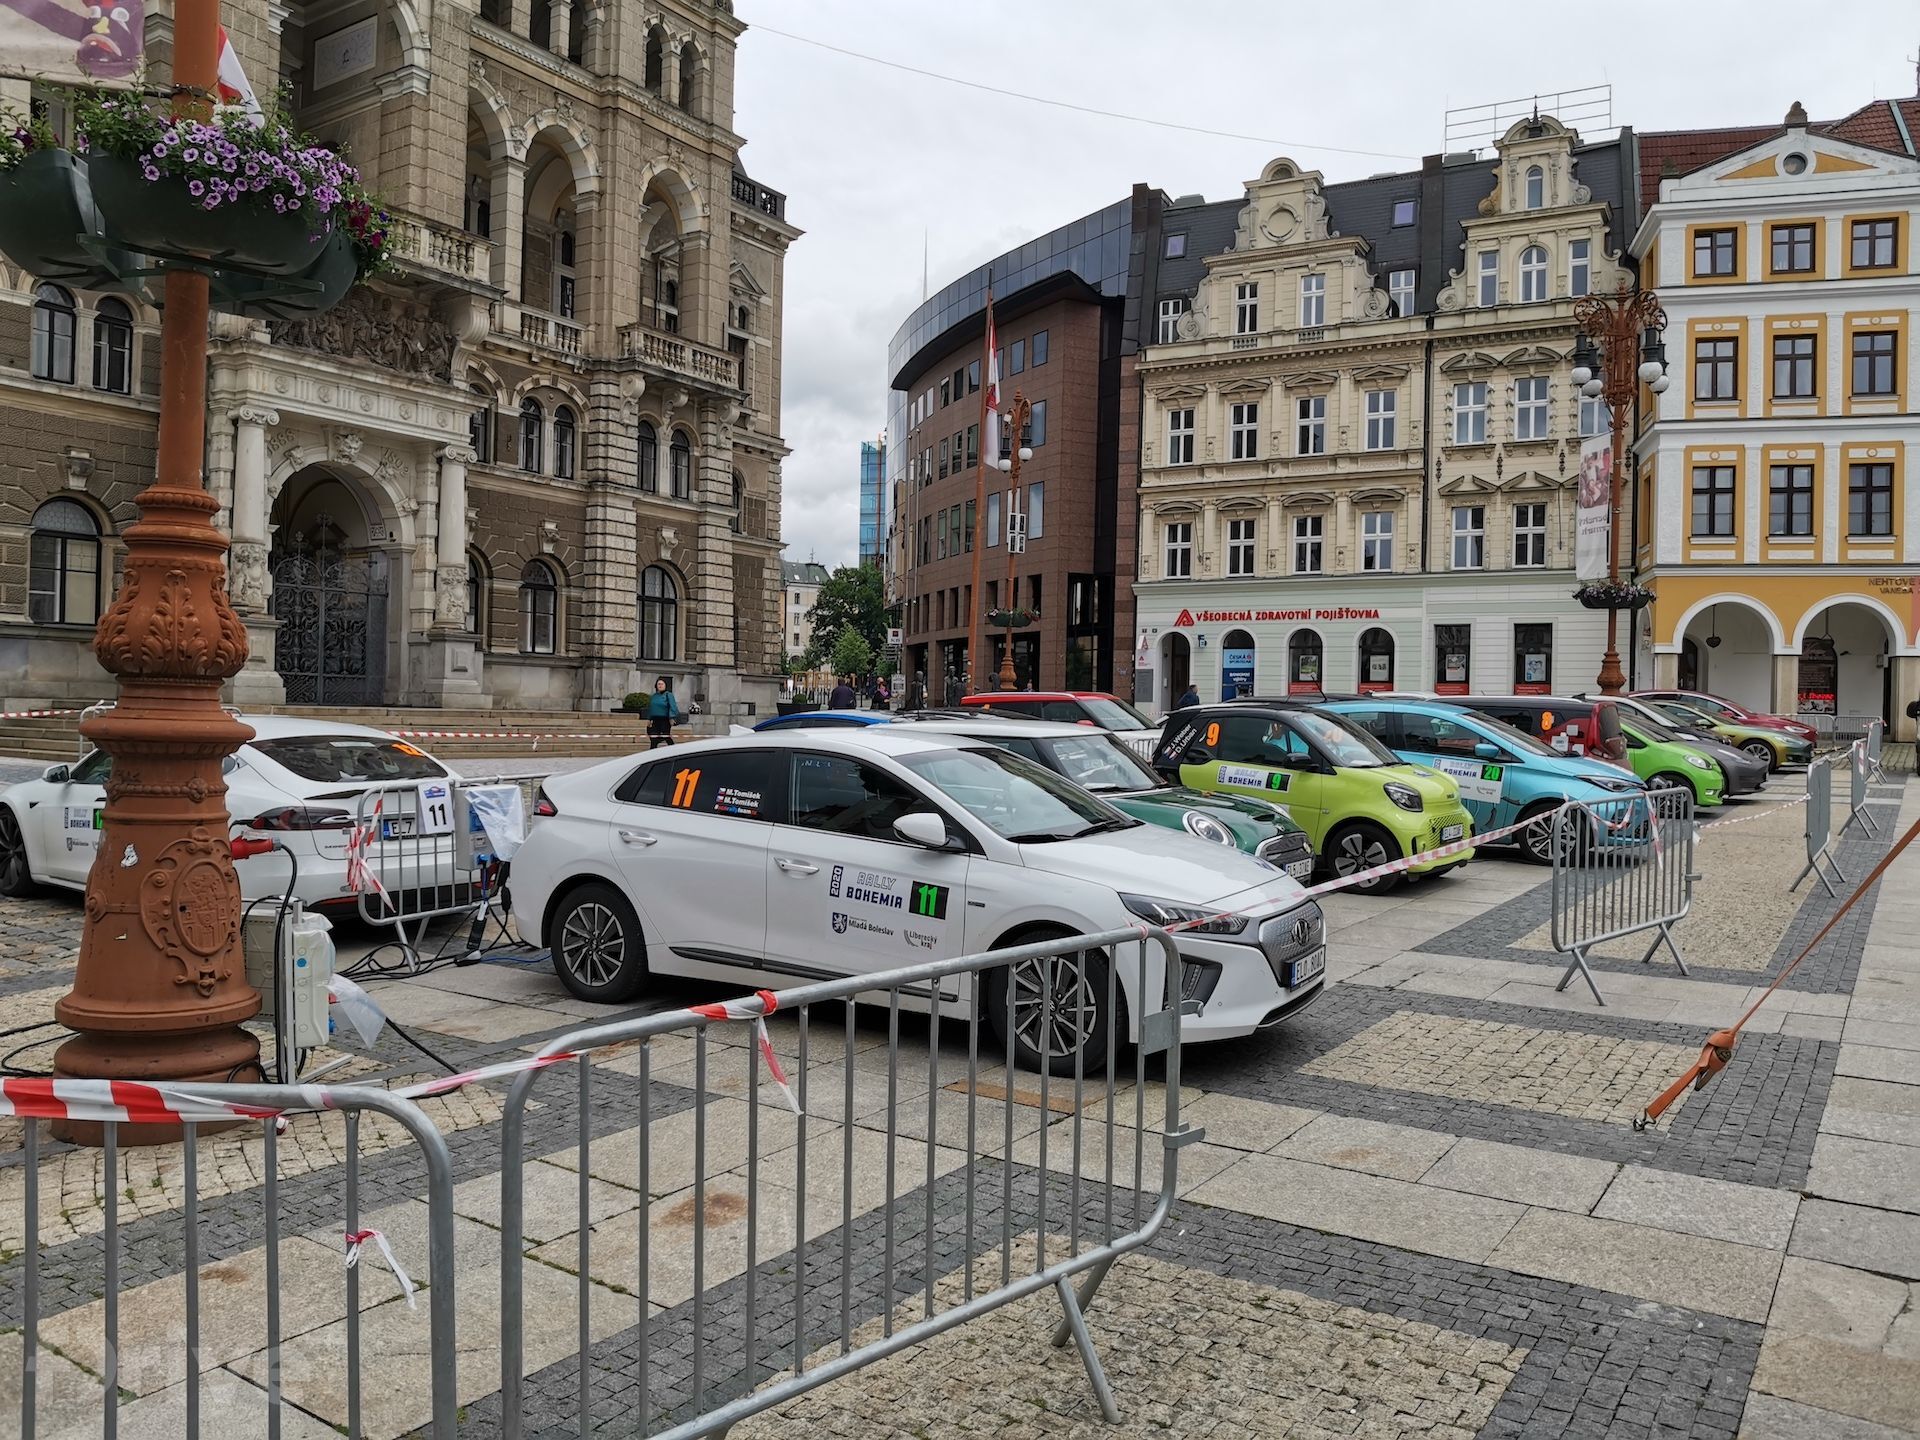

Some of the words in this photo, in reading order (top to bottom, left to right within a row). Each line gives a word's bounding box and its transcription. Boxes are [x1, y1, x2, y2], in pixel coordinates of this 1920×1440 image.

[1196, 610, 1252, 622] VŠEOBECNÁ
[1255, 608, 1311, 621] ZDRAVOTNÍ
[1315, 607, 1380, 621] POJIŠŤOVNA
[1541, 711, 1553, 731] 8
[1206, 722, 1220, 747] 9
[1271, 773, 1282, 789] 9
[1483, 765, 1501, 781] 20
[671, 768, 702, 808] 11
[428, 803, 448, 827] 11
[831, 866, 842, 897] 2020
[857, 871, 897, 890] RALLY
[846, 886, 903, 909] BOHEMIA
[918, 884, 939, 916] 11
[848, 919, 867, 931] Mladá
[868, 923, 895, 936] Boleslav
